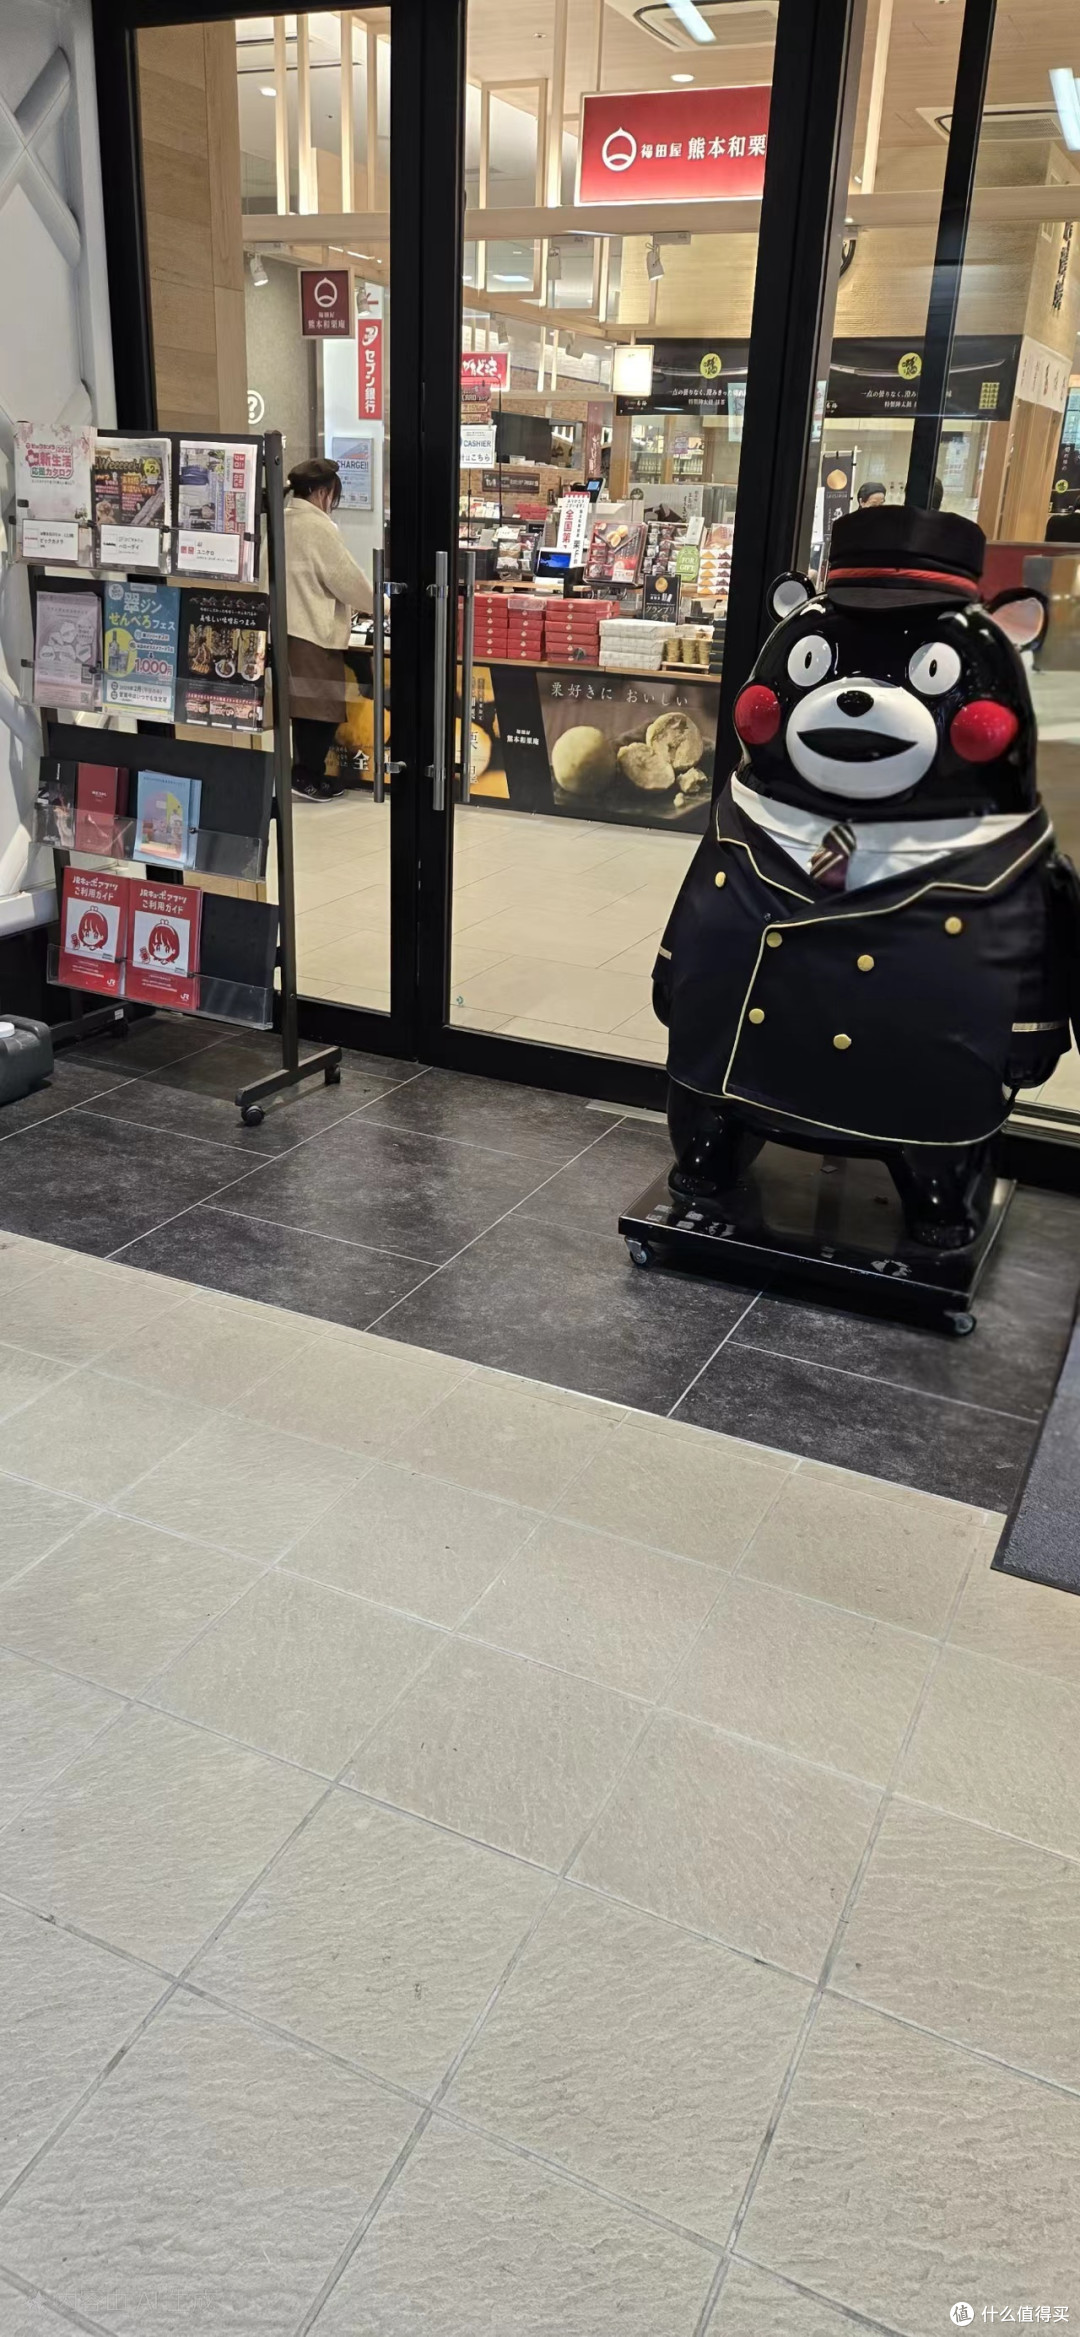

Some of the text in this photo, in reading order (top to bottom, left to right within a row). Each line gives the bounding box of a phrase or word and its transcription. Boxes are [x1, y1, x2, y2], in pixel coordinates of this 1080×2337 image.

[365, 349, 376, 413] セブン銀行
[463, 440, 492, 448] CASHIER
[109, 612, 175, 631] せんべろフェス
[551, 682, 688, 706] 栗好きに おいしい
[74, 887, 114, 901] ご利用ガイド
[142, 900, 184, 914] ご利用ガイド
